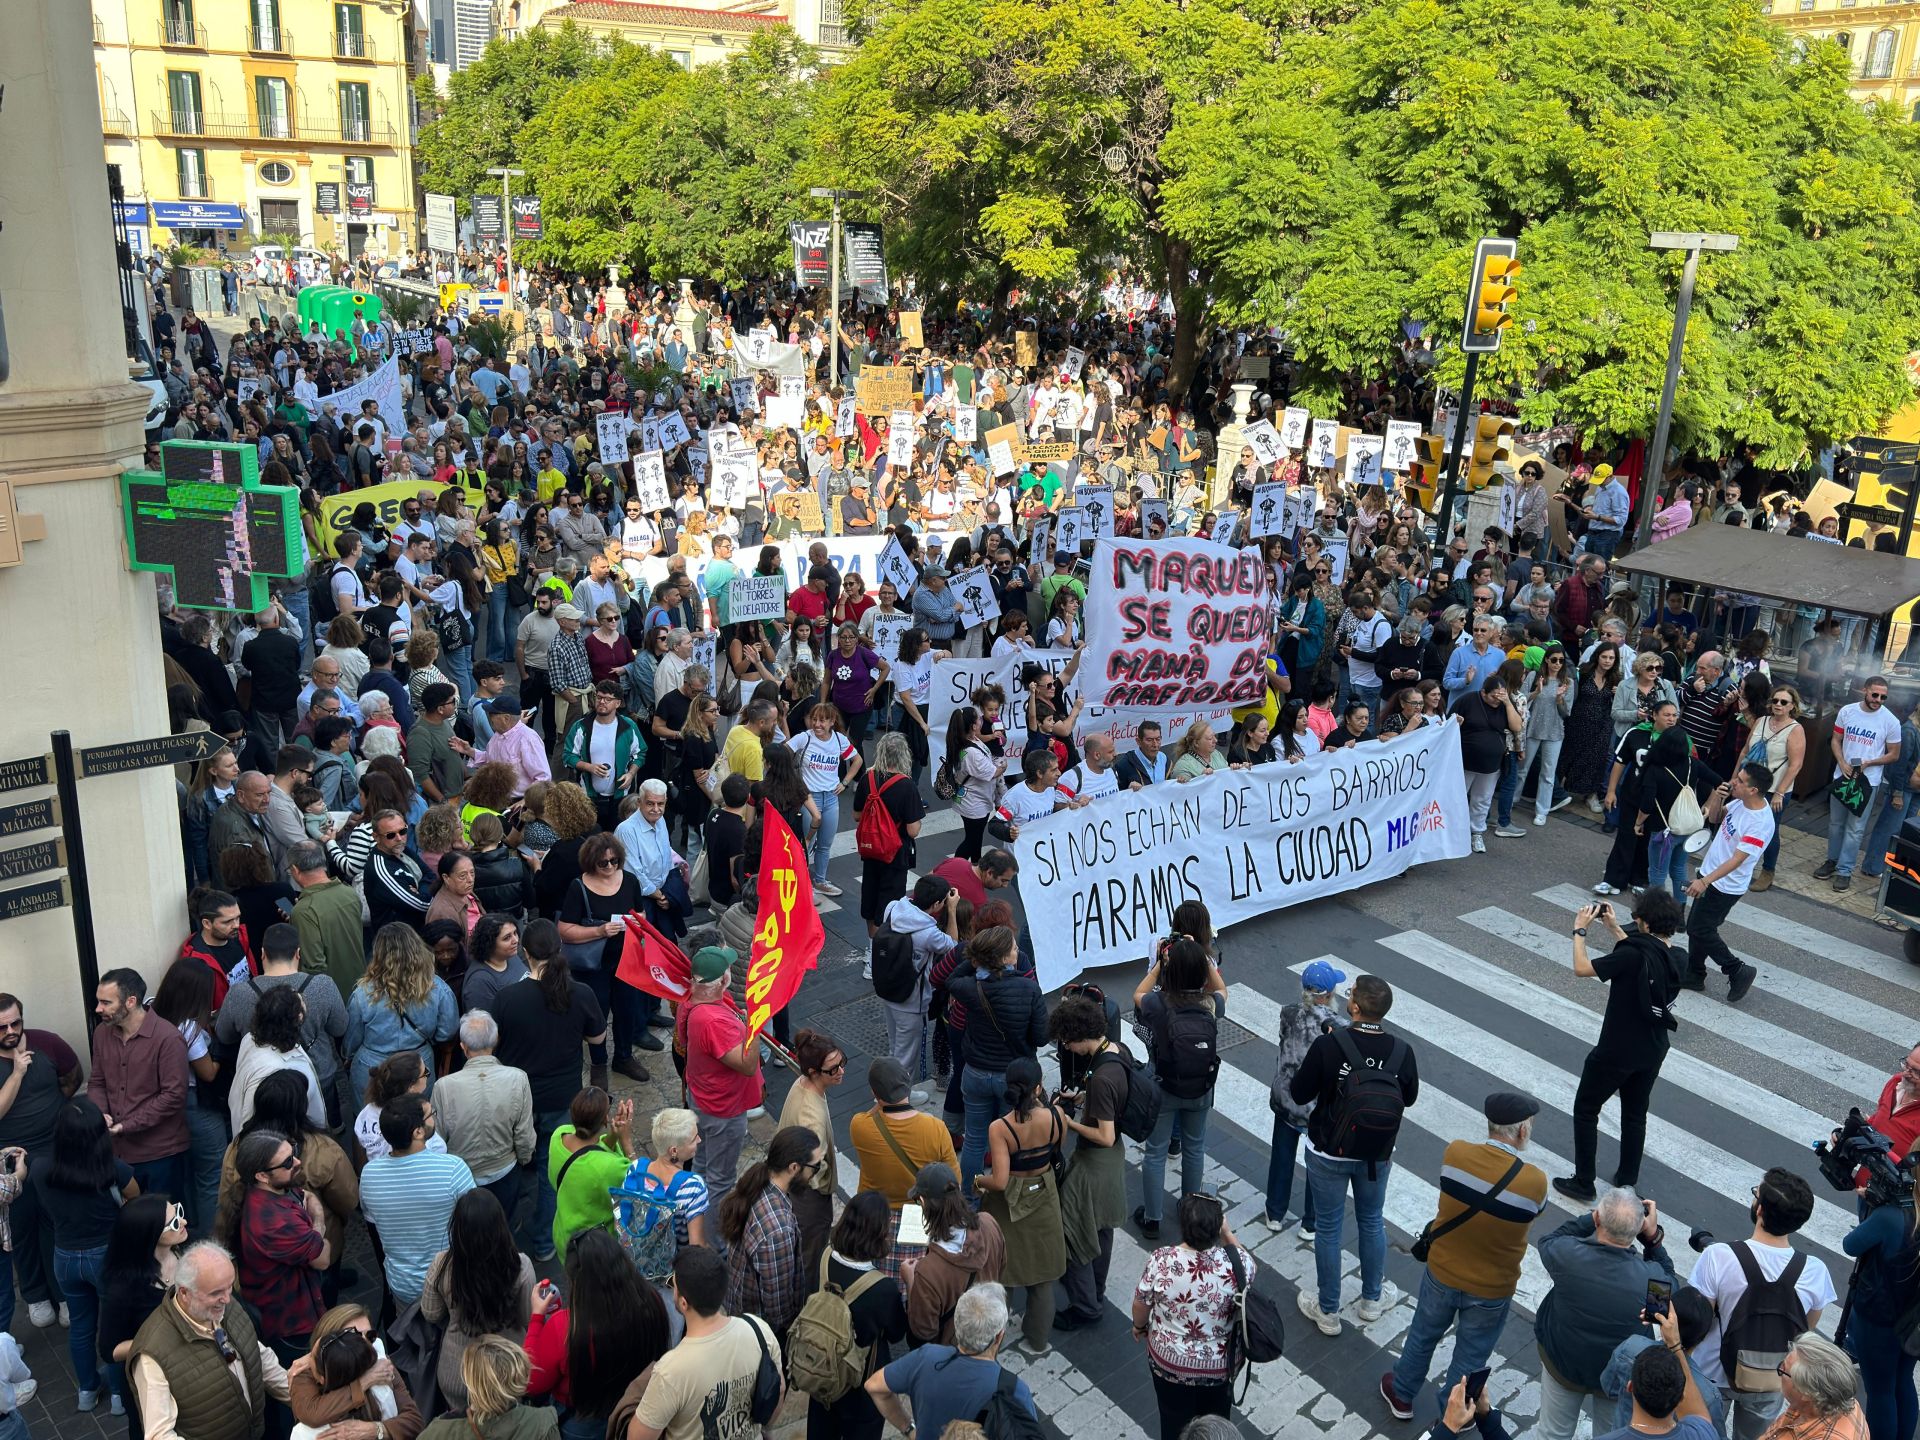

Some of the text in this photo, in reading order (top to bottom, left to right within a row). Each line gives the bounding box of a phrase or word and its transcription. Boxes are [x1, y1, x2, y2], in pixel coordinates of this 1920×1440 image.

[512, 201, 540, 215] JAZZ
[792, 228, 830, 249] JAZZ
[1113, 548, 1266, 597] MAQUED
[732, 588, 774, 602] NI TORRES
[883, 614, 912, 624] BOQUERONES
[1119, 597, 1173, 644] SE
[1229, 643, 1268, 681] DE
[1846, 725, 1877, 740] MÁLAGA
[87, 737, 195, 760] FUNDACIÓN PABLO R. PICASSO
[28, 760, 40, 771] DE
[88, 754, 168, 774] MUSEO CASA NATAL
[810, 753, 839, 765] MÁLAGA
[15, 803, 46, 817] MUSEO
[2, 814, 48, 834] MÁLAGA
[1068, 820, 1116, 867] NOS
[1125, 795, 1201, 857] ECHAN
[1223, 786, 1251, 830] DE
[1267, 776, 1311, 823] LOS
[3, 844, 51, 863] IGLESIA DE
[1072, 812, 1419, 958] PARAMOS LA CIUDAD MLG
[7, 890, 58, 910] AL ÁNDALUS
